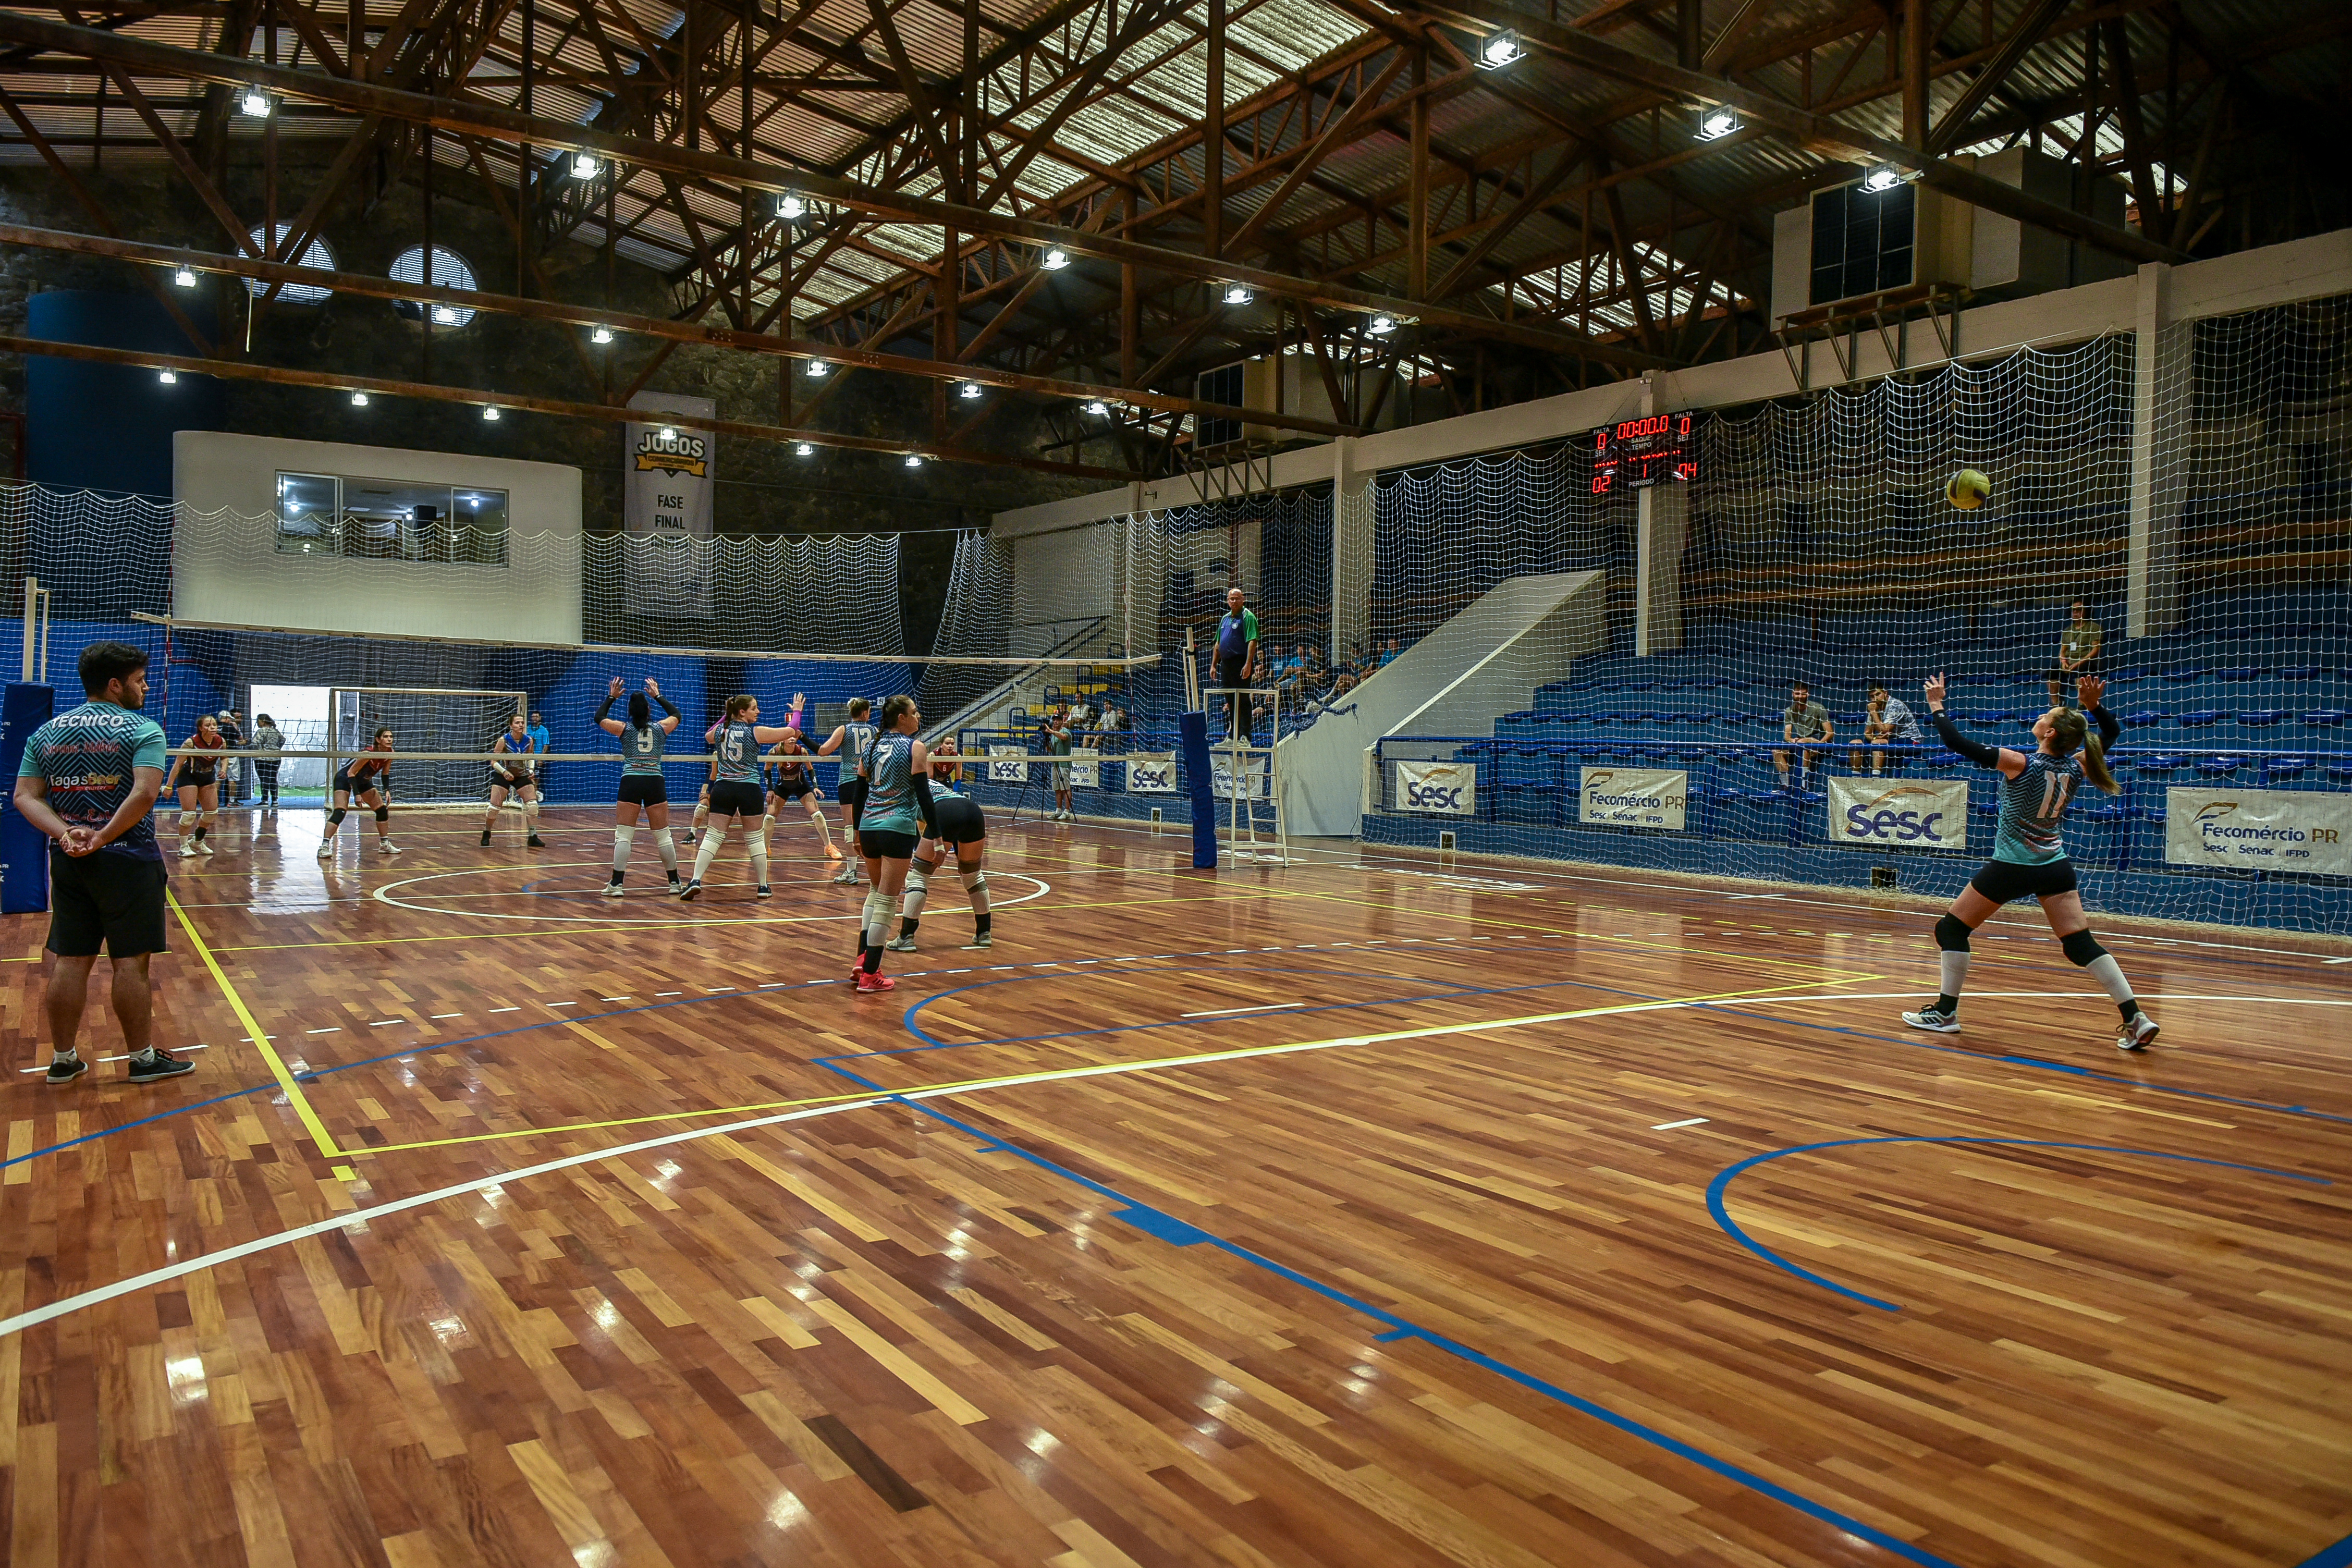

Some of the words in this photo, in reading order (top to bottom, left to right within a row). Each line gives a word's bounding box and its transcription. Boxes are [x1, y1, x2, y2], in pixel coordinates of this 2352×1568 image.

[1681, 417, 1689, 434] 0
[640, 434, 704, 457] JOGOS
[1598, 433, 1607, 449] 0
[1631, 435, 1651, 444] SAQUE
[1677, 434, 1689, 442] SET
[1595, 449, 1605, 457] SET
[1592, 475, 1611, 493] 02
[1628, 479, 1654, 487] PERÍODO
[658, 494, 684, 509] FASE
[655, 514, 685, 530] FINAL
[52, 715, 124, 729] TECNICO
[638, 728, 653, 752] 9
[721, 729, 744, 762] 15
[852, 727, 872, 754] 12
[874, 744, 893, 785] 7
[994, 761, 1021, 778] Sesc
[1090, 765, 1098, 775] PR
[1132, 768, 1168, 788] Sesc
[1408, 781, 1462, 809] Sesc
[1589, 791, 1660, 808] Fecomércio
[1665, 795, 1685, 810] PR
[1589, 809, 1607, 820] Sesc
[1612, 811, 1637, 822] Senac
[1646, 815, 1663, 824] IFPD
[1845, 804, 1943, 842] Sesc
[2202, 822, 2306, 842] Fecomércio
[2312, 828, 2339, 844] PR
[2203, 842, 2228, 853] Sesc
[2238, 844, 2274, 856] Senac
[2286, 849, 2310, 858] IFPD
